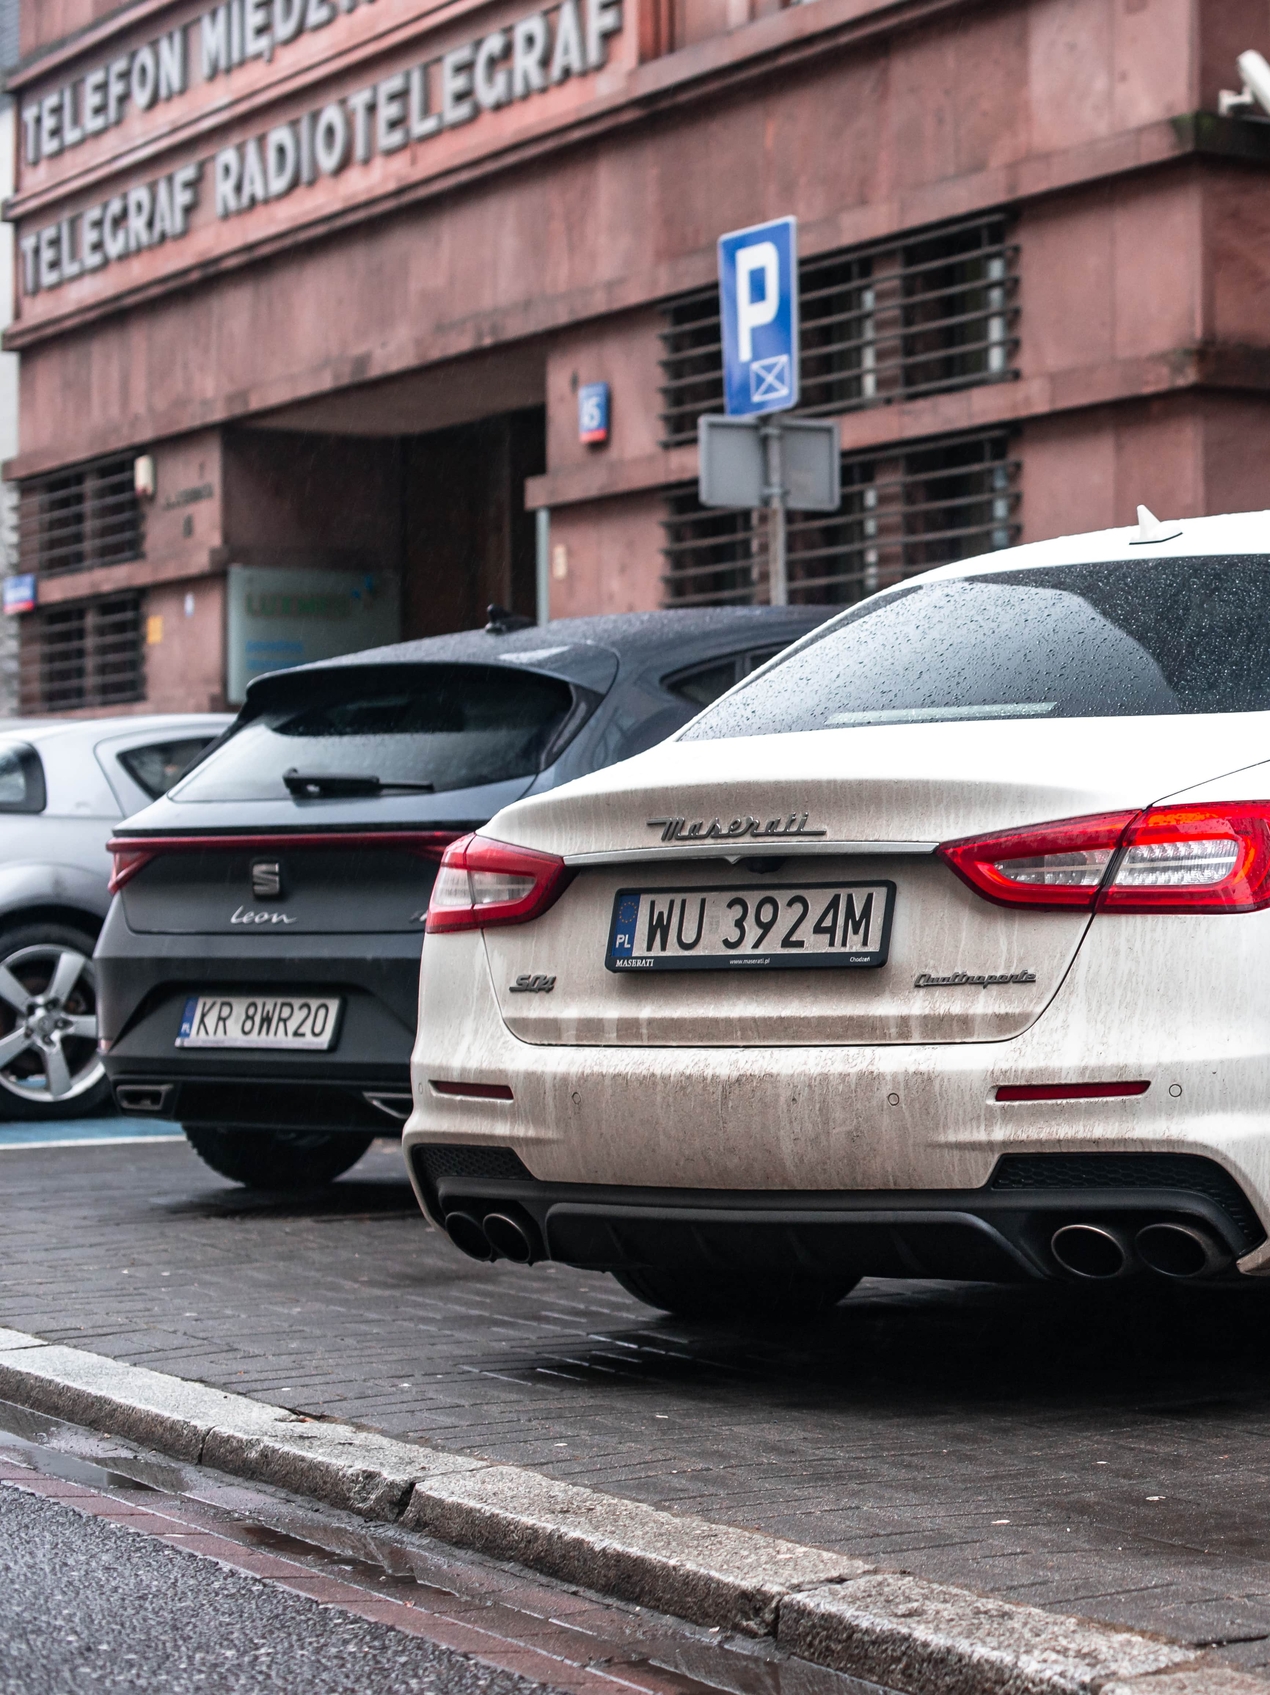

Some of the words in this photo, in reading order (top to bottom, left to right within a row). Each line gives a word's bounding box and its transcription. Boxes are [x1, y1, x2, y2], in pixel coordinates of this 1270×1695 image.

[22, 28, 184, 166] TELEFON
[20, 163, 199, 296] TELEGRAF
[215, 0, 626, 219] RADIOTELEGRAF
[736, 241, 780, 364] P
[646, 811, 827, 842] Maserati
[230, 905, 297, 925] Leon
[645, 897, 706, 953] WU
[721, 892, 875, 949] 3924M
[615, 933, 632, 949] PL
[615, 958, 654, 968] MASERATI
[729, 956, 771, 966] www.maserati.pl
[197, 1001, 233, 1037] KR
[240, 1001, 329, 1037] 8WR20
